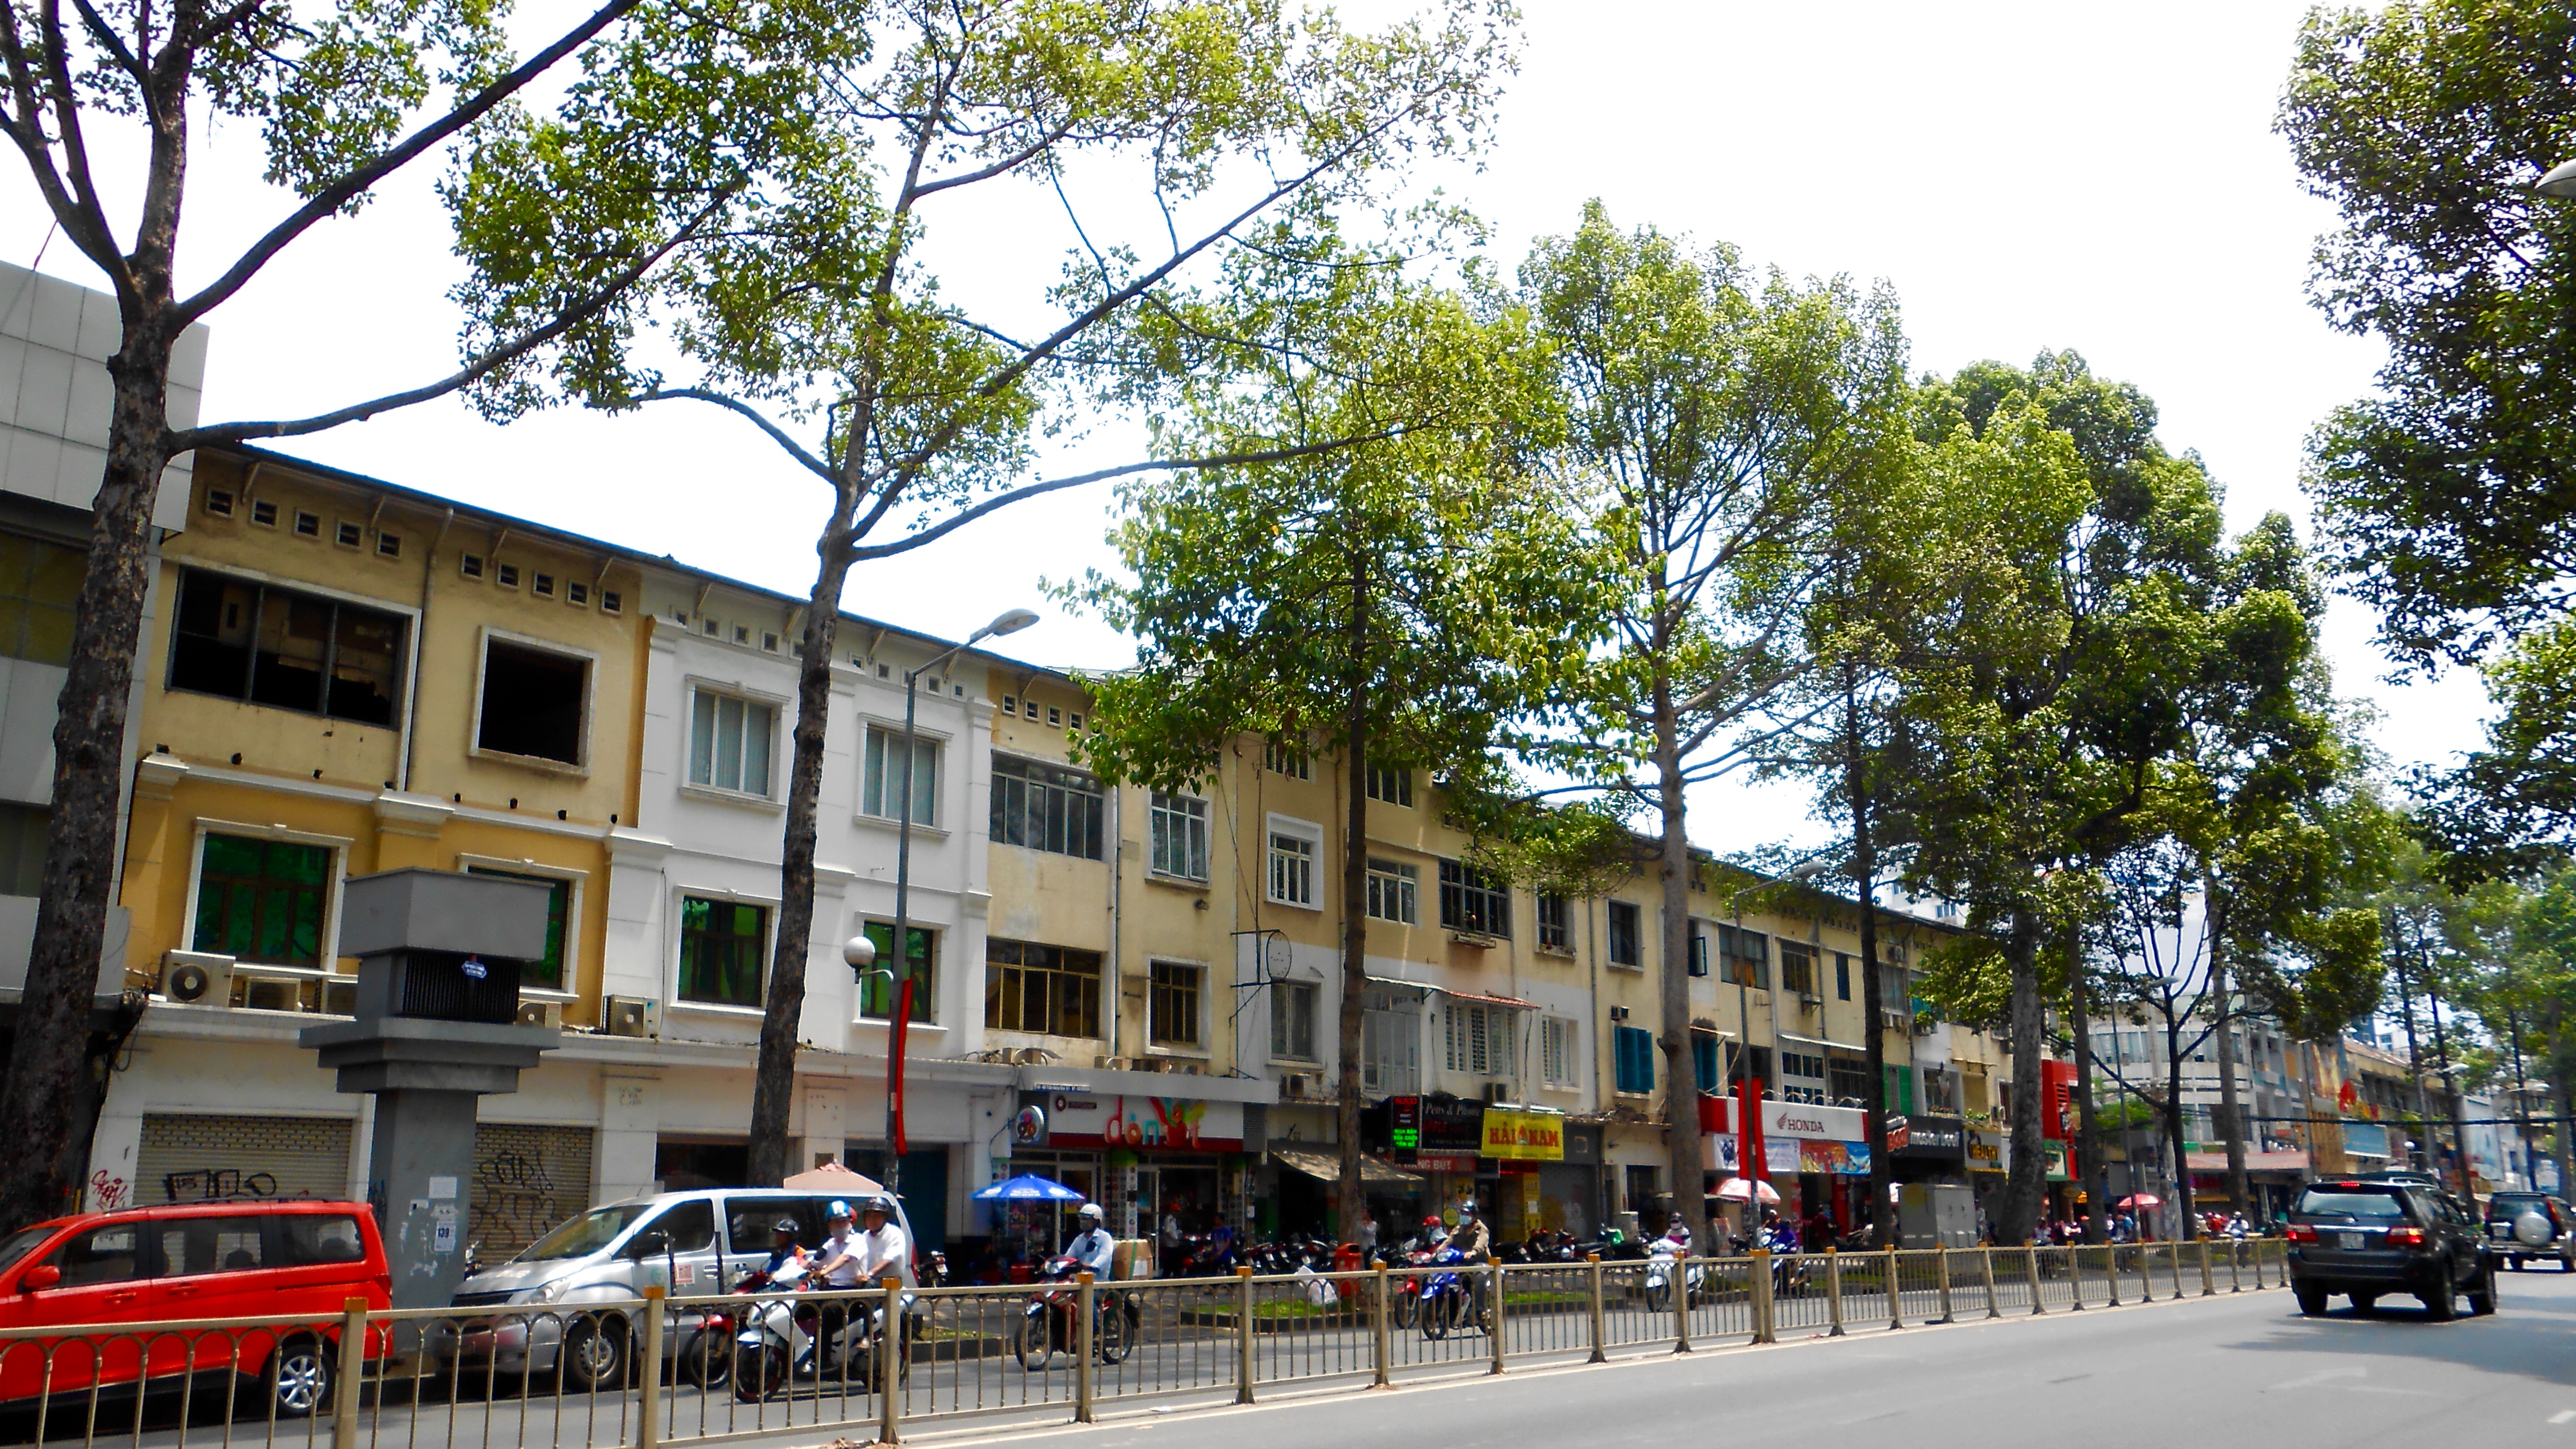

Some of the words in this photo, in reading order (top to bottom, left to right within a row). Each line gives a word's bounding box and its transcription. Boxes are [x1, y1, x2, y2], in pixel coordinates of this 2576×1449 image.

[1446, 1104, 1454, 1116] &
[1787, 1119, 1825, 1133] HONDA
[1529, 1129, 1560, 1147] NAM
[1910, 1129, 1939, 1146] master
